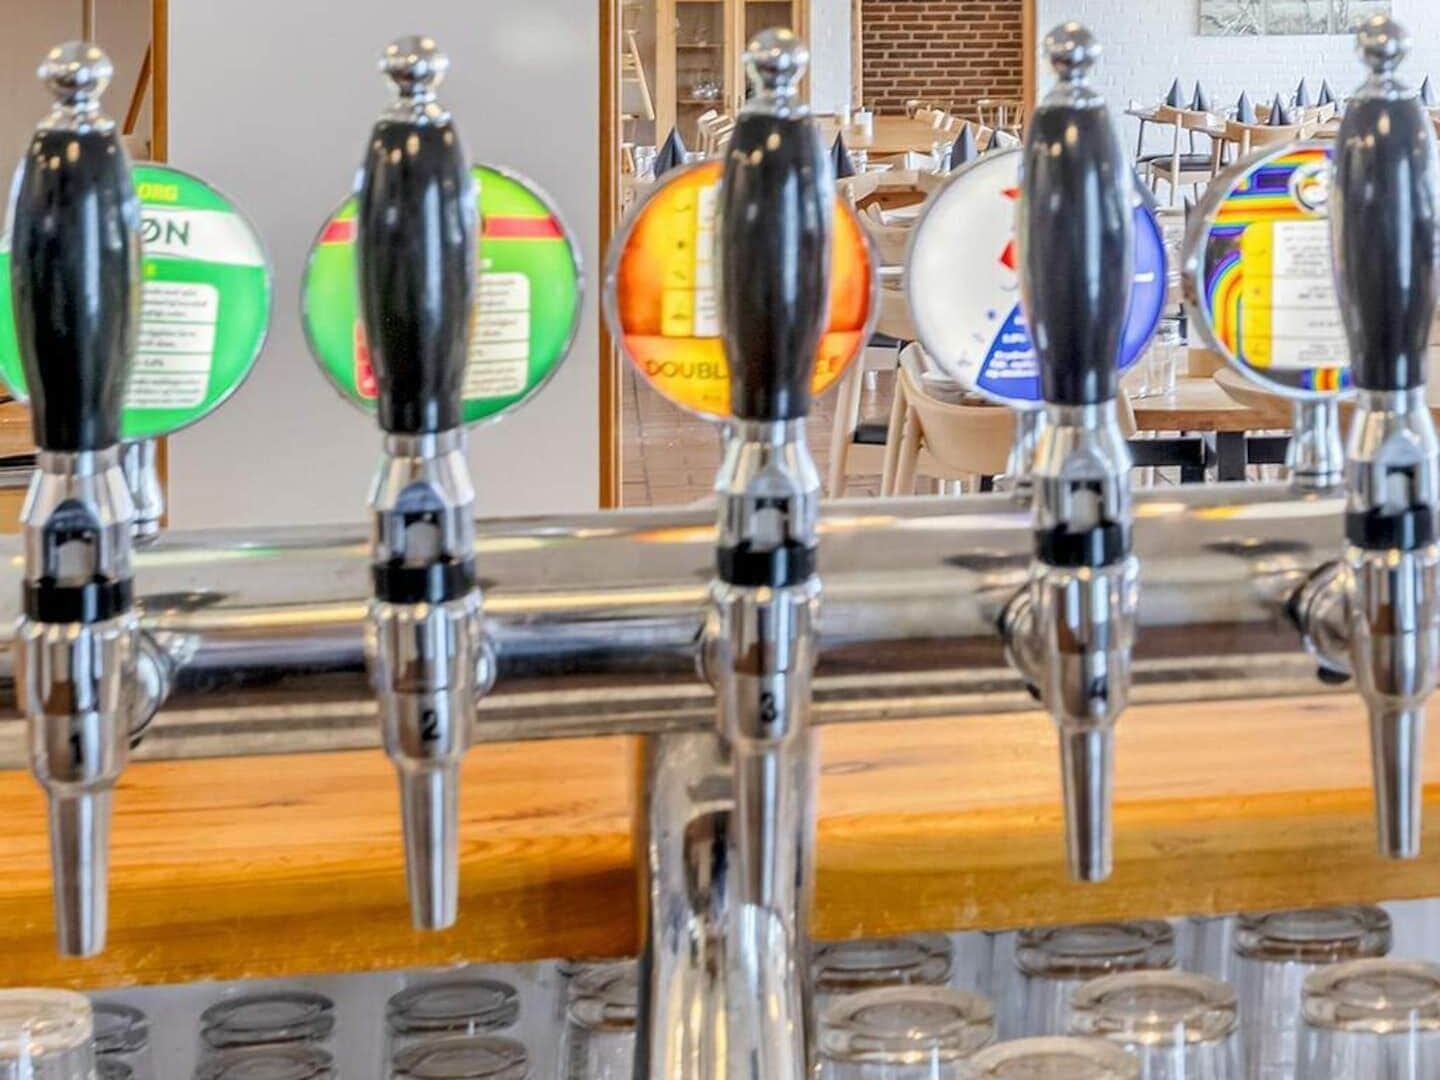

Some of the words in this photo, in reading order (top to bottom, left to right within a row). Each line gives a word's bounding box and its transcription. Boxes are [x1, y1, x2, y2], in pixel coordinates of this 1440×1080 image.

[645, 360, 729, 380] DOUBL
[760, 691, 778, 723] 3
[421, 709, 441, 741] 2
[69, 731, 84, 764] 1
